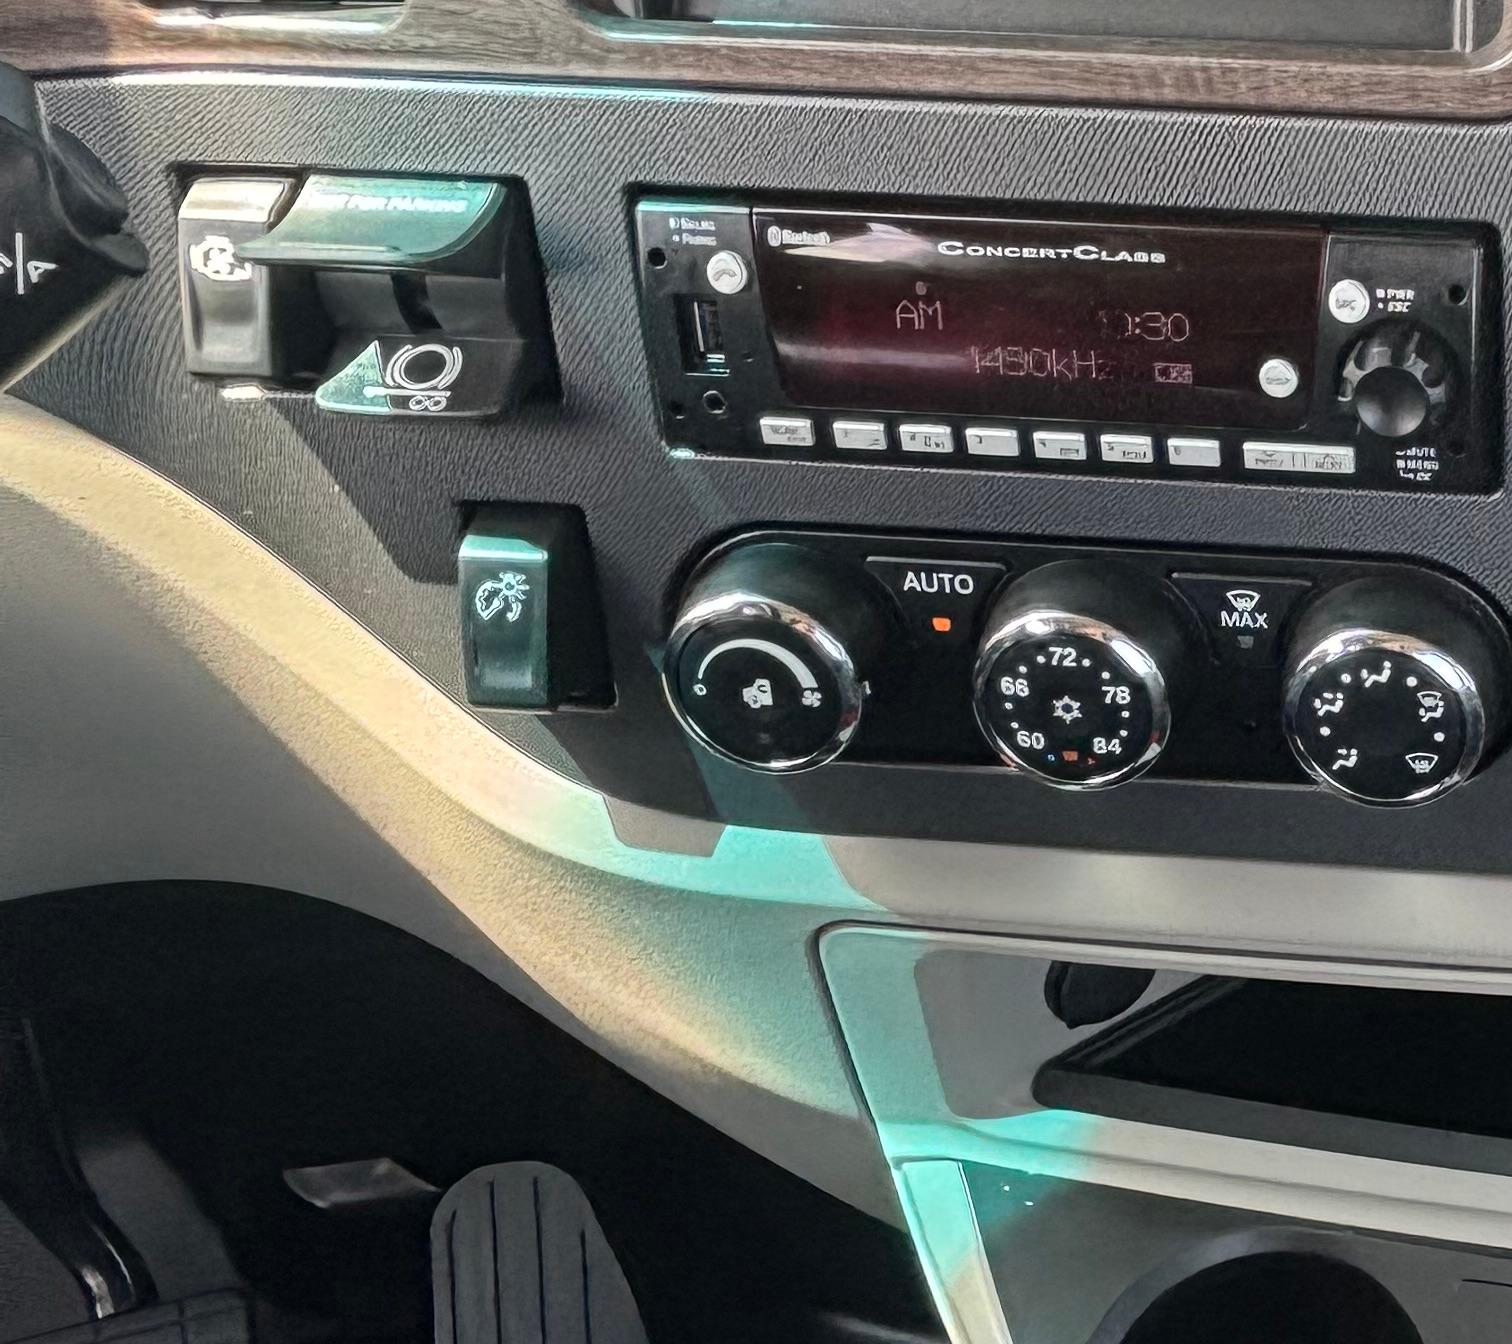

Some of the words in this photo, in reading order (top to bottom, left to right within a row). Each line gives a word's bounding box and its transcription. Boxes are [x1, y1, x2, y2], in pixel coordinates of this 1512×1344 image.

[895, 299, 944, 331] AM
[903, 571, 974, 595] AUTO
[1220, 611, 1269, 629] MAX
[1048, 646, 1077, 667] 72
[1000, 676, 1030, 697] 66
[1101, 685, 1131, 705] 78
[1016, 730, 1045, 750] 60
[1092, 737, 1122, 755] 84
